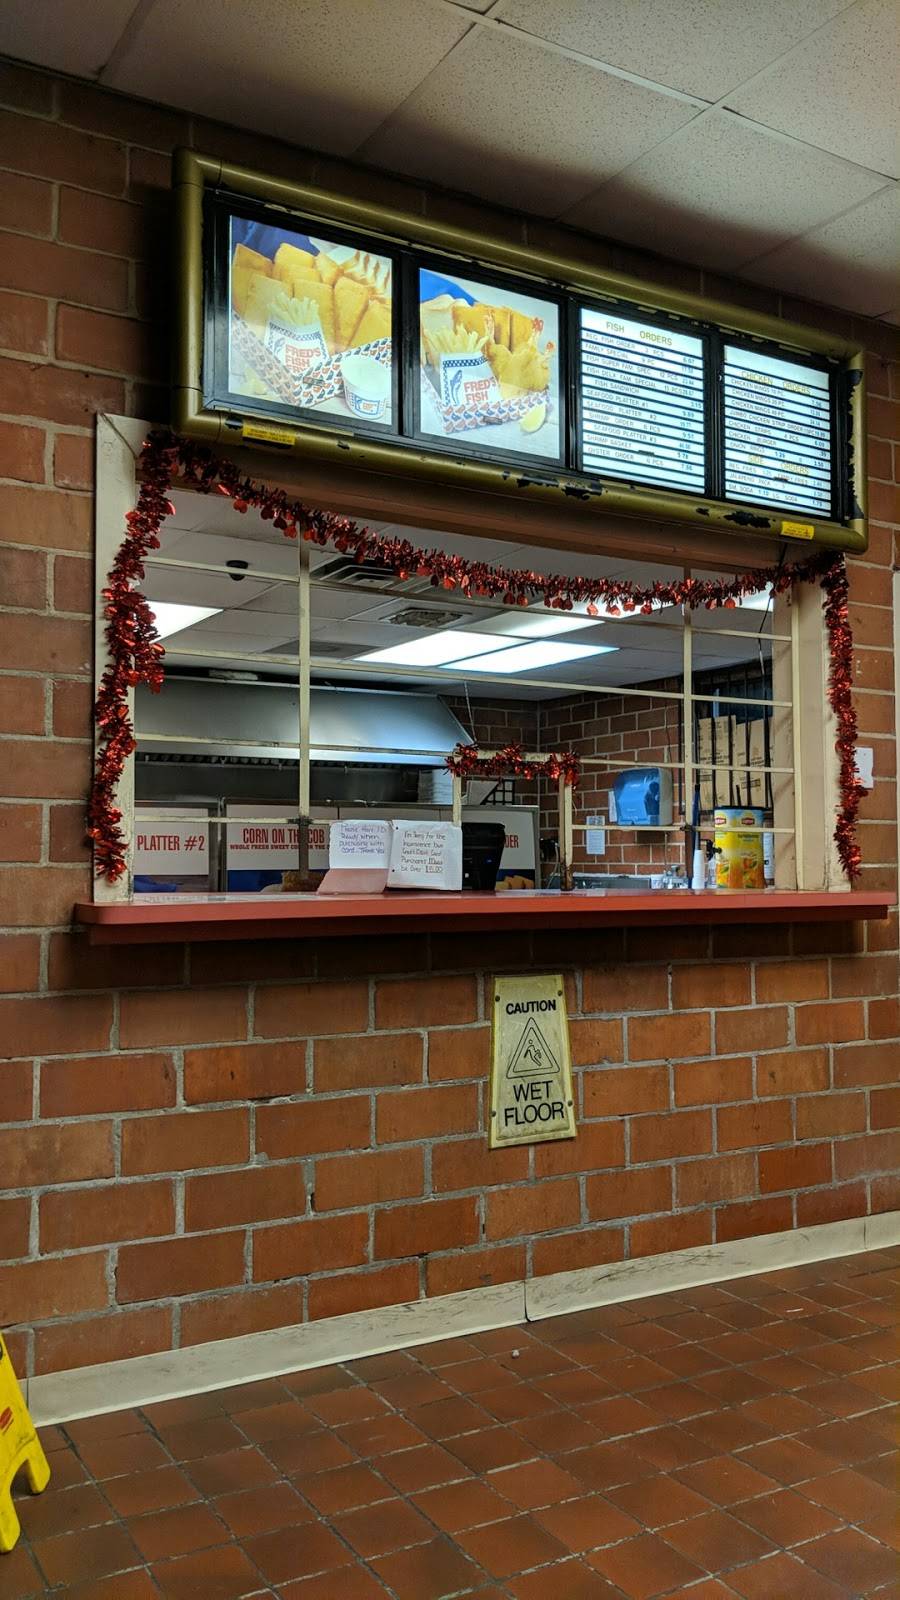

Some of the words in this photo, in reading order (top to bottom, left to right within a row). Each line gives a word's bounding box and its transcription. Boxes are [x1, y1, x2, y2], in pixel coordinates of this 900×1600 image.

[605, 320, 624, 333] FISH
[639, 329, 672, 346] ORDERS
[285, 344, 321, 358] FRED'S
[285, 355, 310, 367] FISH
[463, 375, 498, 393] FRED'S
[741, 369, 773, 385] CHICKEN
[782, 380, 810, 394] ORDERS
[465, 390, 489, 405] FISH
[780, 460, 808, 474] ORDERS
[137, 835, 180, 851] PLATTER
[184, 835, 205, 851] #2
[243, 828, 269, 844] CORN
[272, 828, 285, 844] ON
[287, 828, 299, 844] TH
[308, 828, 325, 844] COB
[505, 835, 519, 848] DER
[505, 999, 556, 1015] CAUTION
[513, 1080, 553, 1102] WET
[504, 1101, 565, 1127] FLOOR
